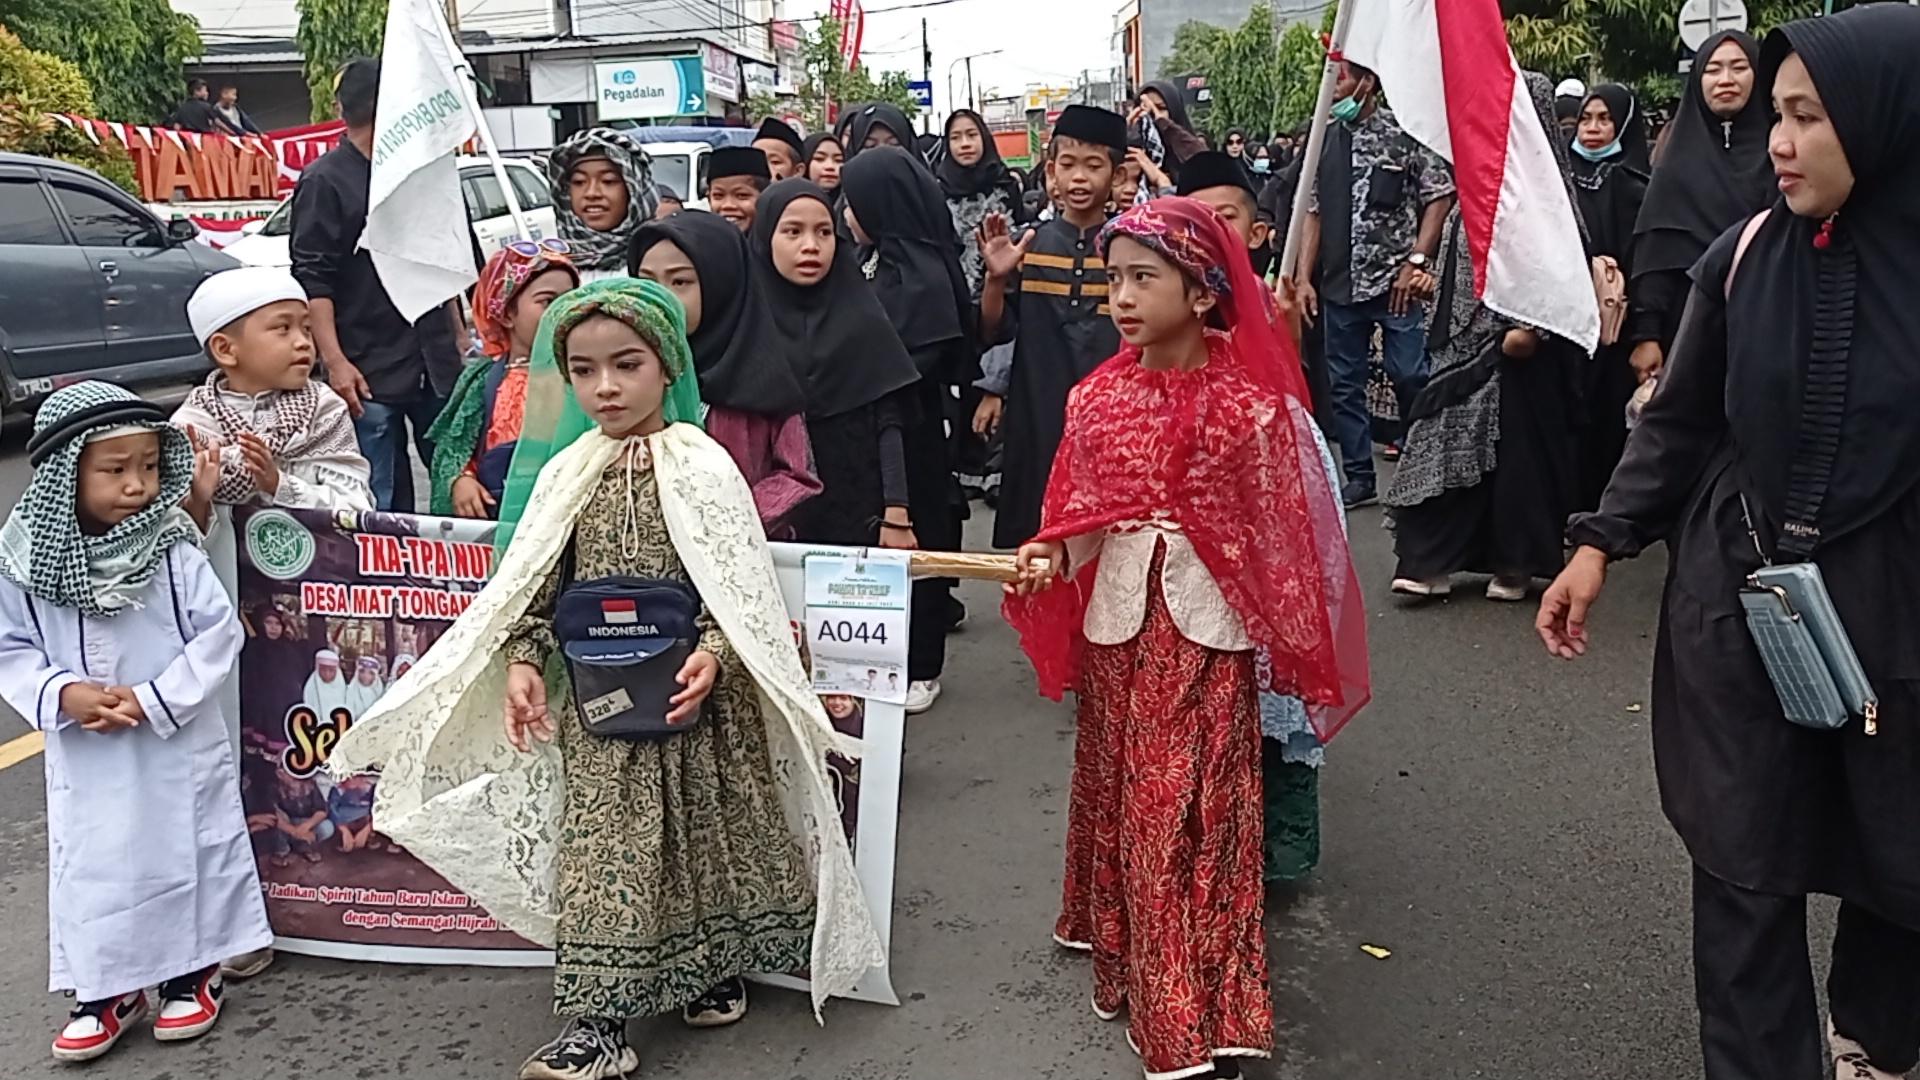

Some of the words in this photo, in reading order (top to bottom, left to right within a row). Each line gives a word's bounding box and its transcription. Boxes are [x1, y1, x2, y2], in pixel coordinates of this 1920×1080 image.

[604, 86, 665, 102] Pegadaian
[18, 378, 53, 395] TRD
[357, 535, 450, 579] TKA-TPA
[303, 584, 348, 614] DESA
[352, 588, 393, 617] MAT
[398, 588, 478, 618] TONGAN
[587, 624, 659, 637] INDONESIA
[817, 619, 888, 645] A044
[270, 884, 316, 900] Jadikan
[319, 886, 353, 904] Spirit
[355, 888, 394, 904] Tahun
[398, 891, 428, 905] Baru
[431, 892, 466, 906] Islam
[344, 910, 389, 927] dengan
[392, 913, 454, 930] Semangat
[458, 916, 497, 931] Hijrah
